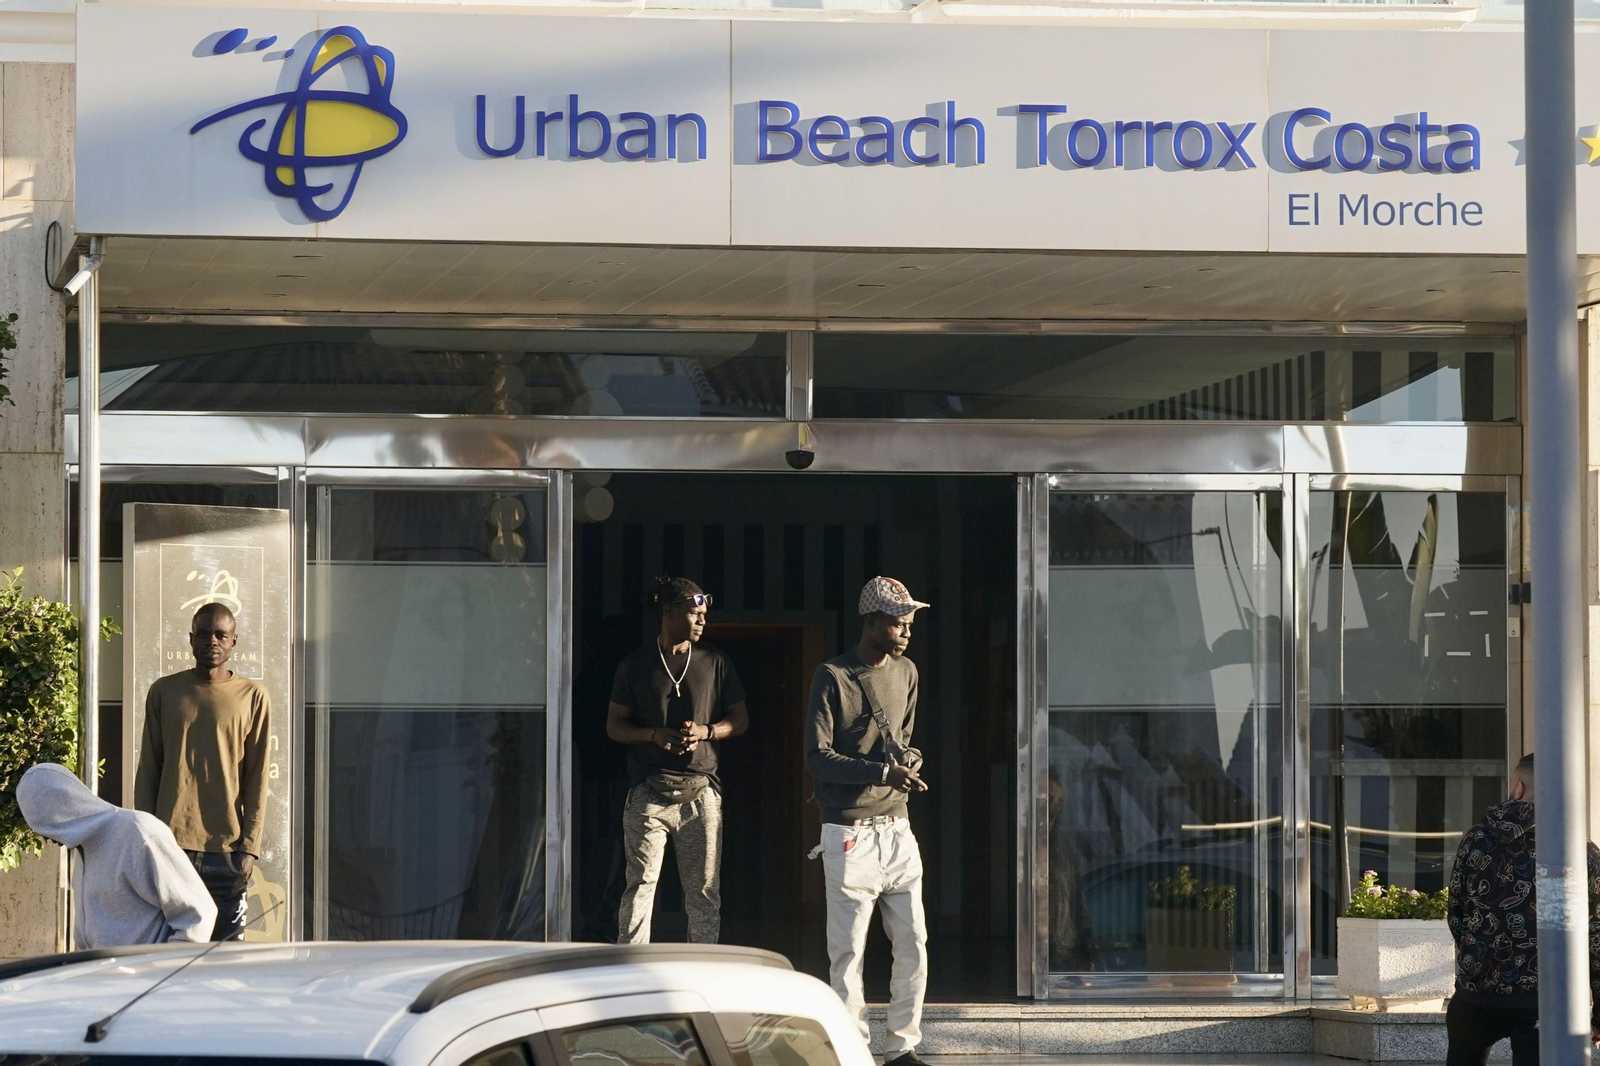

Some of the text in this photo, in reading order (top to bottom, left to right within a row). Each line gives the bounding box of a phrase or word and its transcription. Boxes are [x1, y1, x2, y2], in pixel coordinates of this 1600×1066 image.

[475, 93, 1481, 172] Urban Beach Torrox Costa
[1288, 193, 1483, 226] El Morche
[167, 664, 257, 673] HOLS
